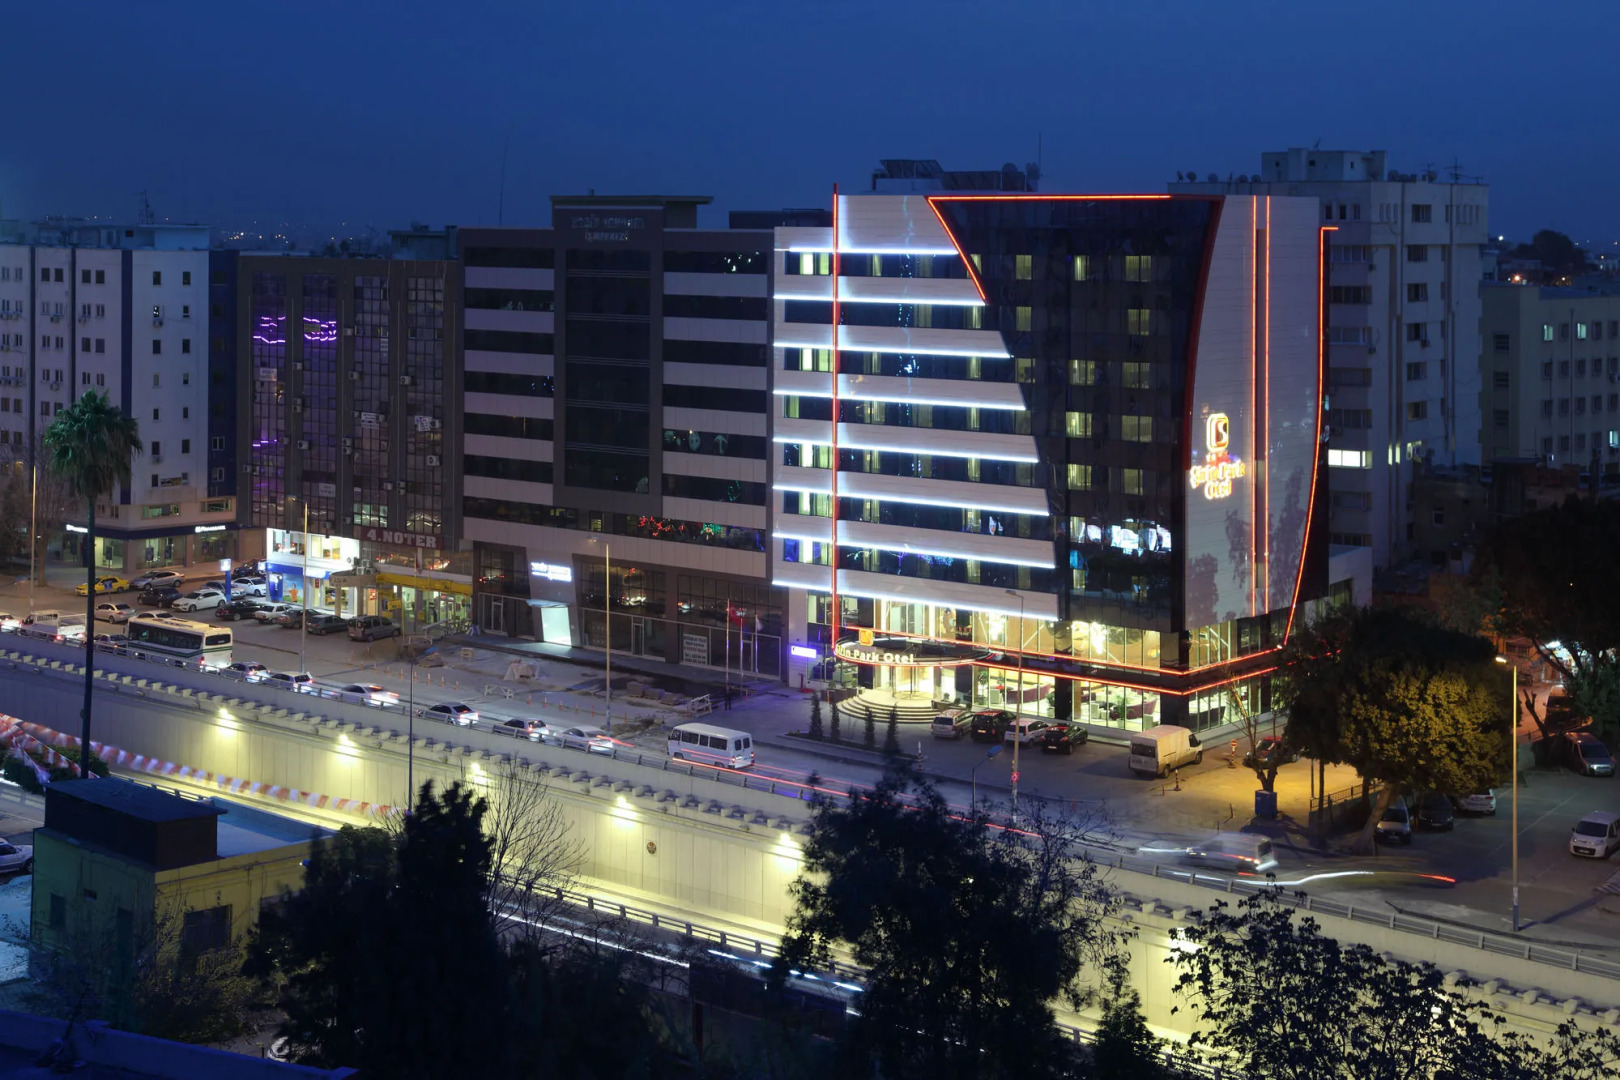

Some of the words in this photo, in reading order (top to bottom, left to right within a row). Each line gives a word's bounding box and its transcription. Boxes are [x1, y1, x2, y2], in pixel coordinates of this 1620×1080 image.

[1204, 478, 1232, 500] Otel
[366, 528, 437, 548] 4.NOTER
[853, 649, 880, 662] Park
[883, 652, 914, 664] Otel
